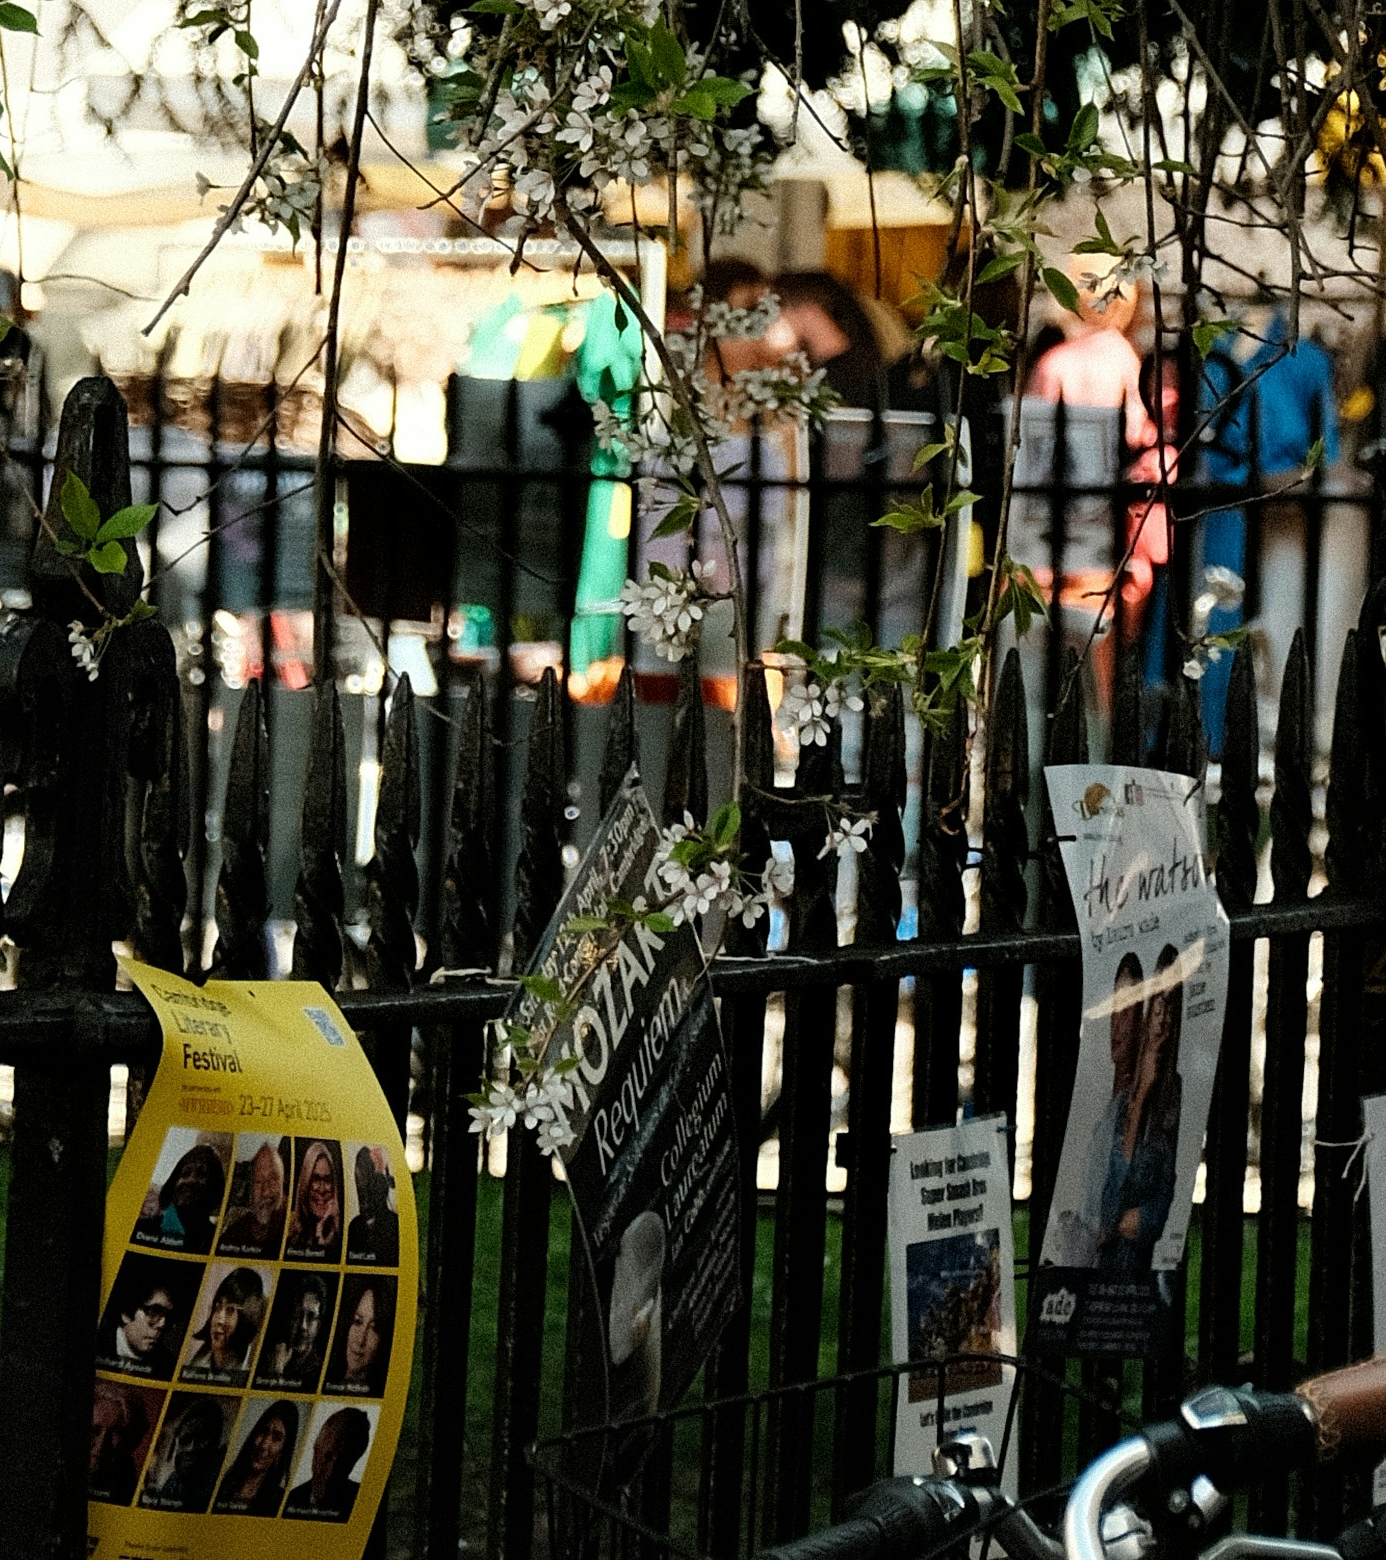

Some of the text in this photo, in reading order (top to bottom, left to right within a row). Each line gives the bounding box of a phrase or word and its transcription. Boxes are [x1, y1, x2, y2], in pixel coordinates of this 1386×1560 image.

[171, 1009, 232, 1044] Literary
[183, 1043, 243, 1073] Festival
[594, 977, 685, 1176] Requiem
[277, 1098, 303, 1123] April
[304, 1099, 332, 1123] 2025
[660, 1052, 724, 1187] Collegium
[910, 1158, 943, 1180] Looking
[944, 1157, 956, 1175] for
[921, 1186, 945, 1205] Super
[946, 1182, 971, 1202] Smash
